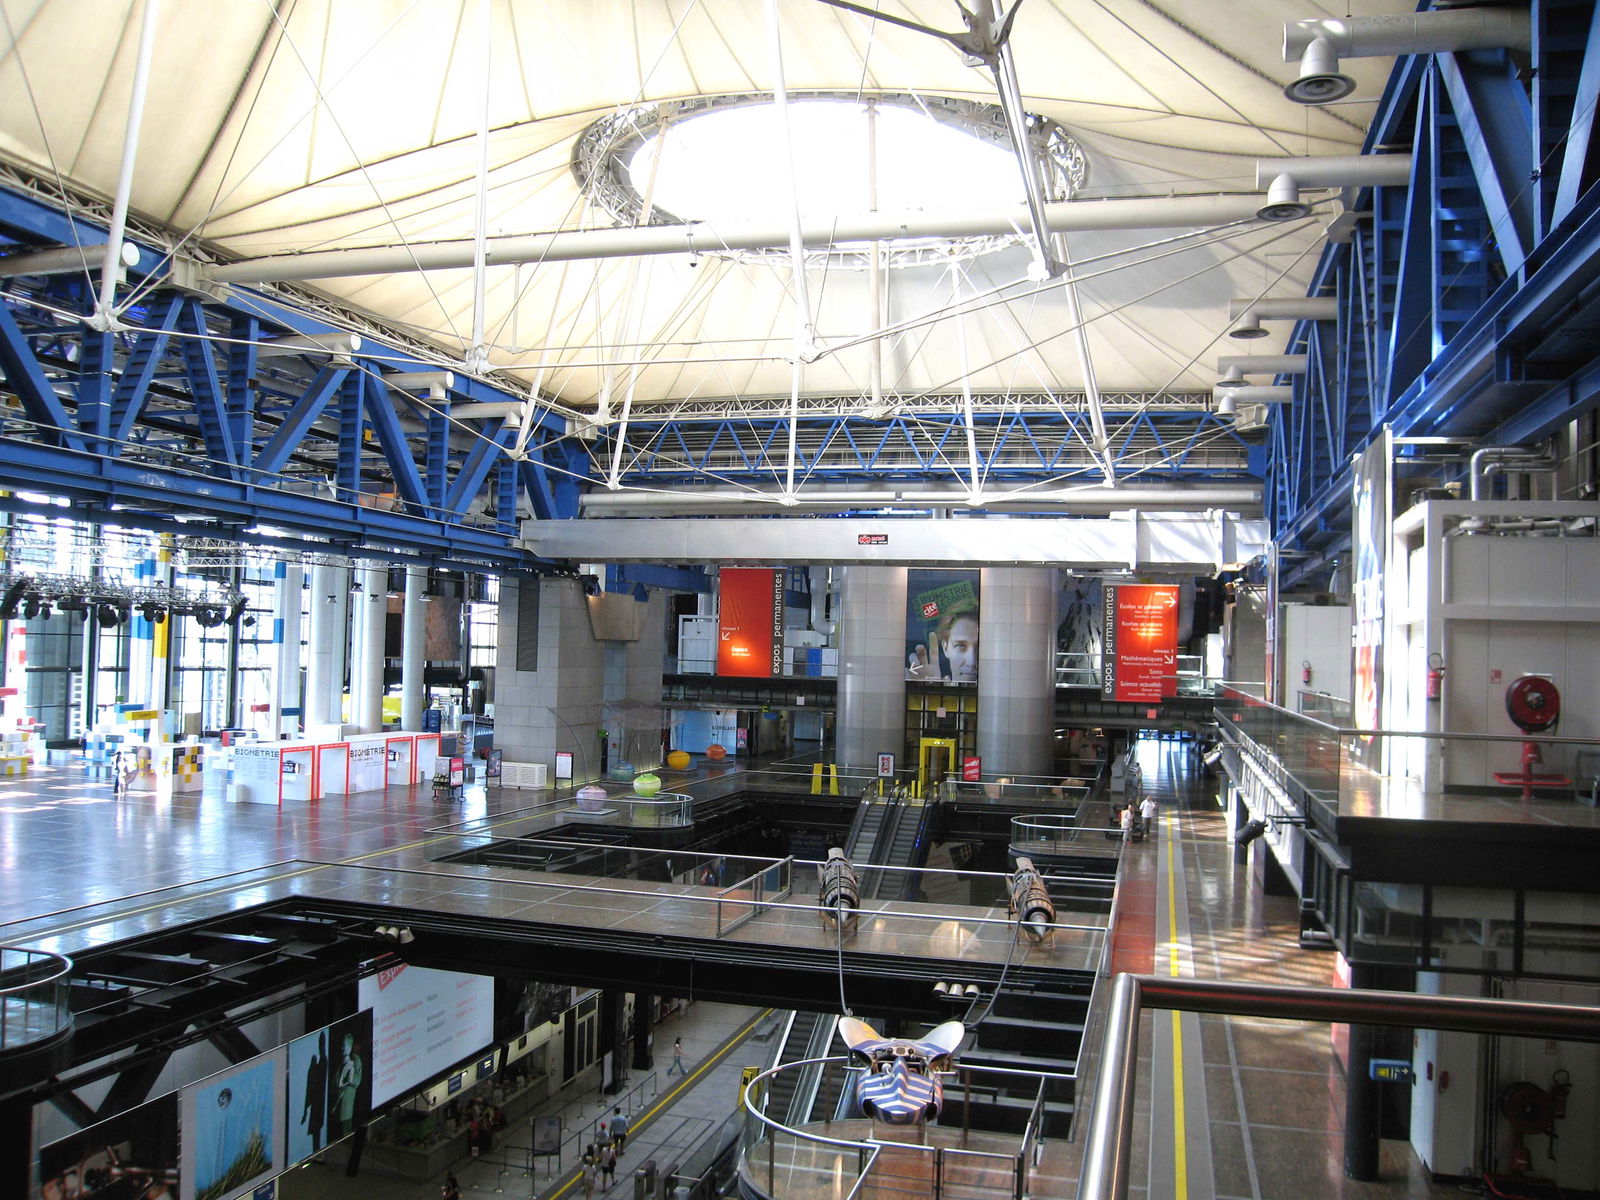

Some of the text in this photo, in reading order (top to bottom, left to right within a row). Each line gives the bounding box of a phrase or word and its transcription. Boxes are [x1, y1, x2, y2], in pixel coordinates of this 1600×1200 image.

[773, 573, 783, 674] expos permanentes
[1104, 587, 1116, 694] expos permanentes
[1120, 655, 1163, 663] Mathématiques
